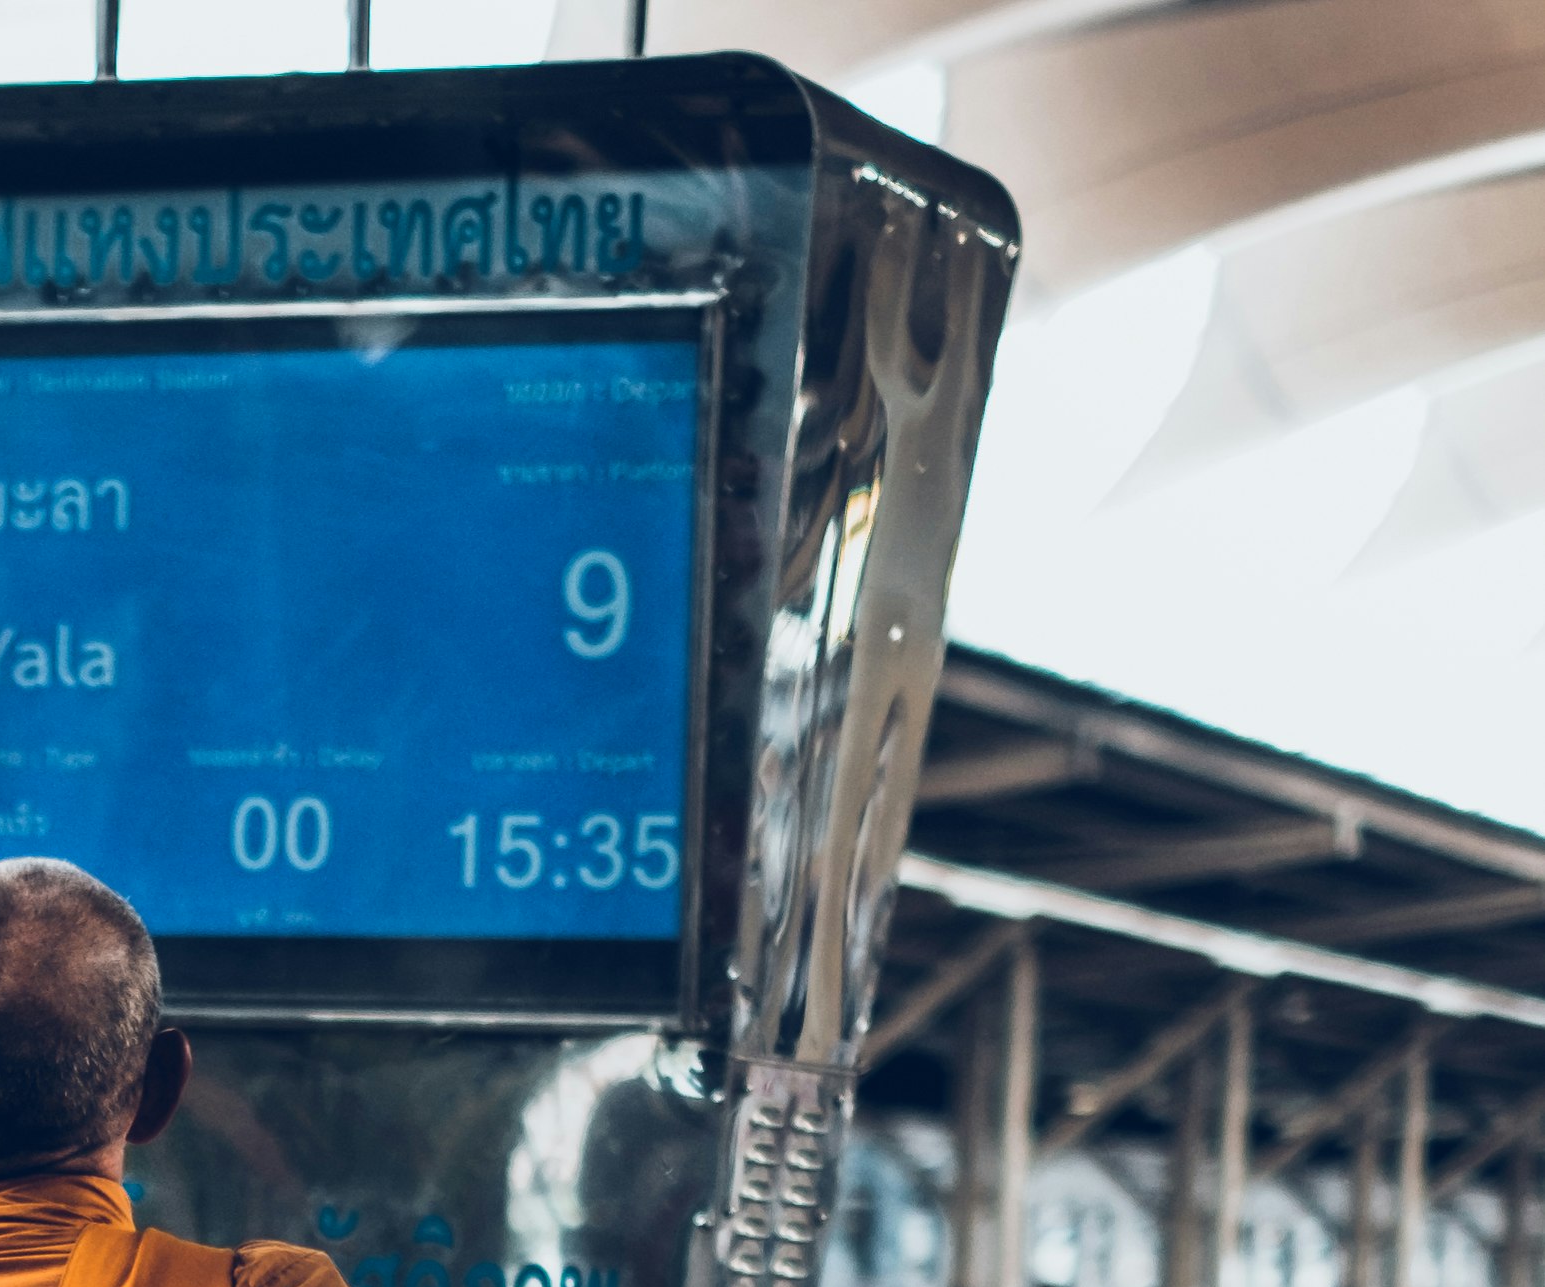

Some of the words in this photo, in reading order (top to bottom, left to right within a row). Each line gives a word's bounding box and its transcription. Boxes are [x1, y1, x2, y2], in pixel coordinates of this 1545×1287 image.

[562, 548, 631, 659] 9
[231, 796, 331, 872] 00
[448, 813, 680, 890] 15:35
